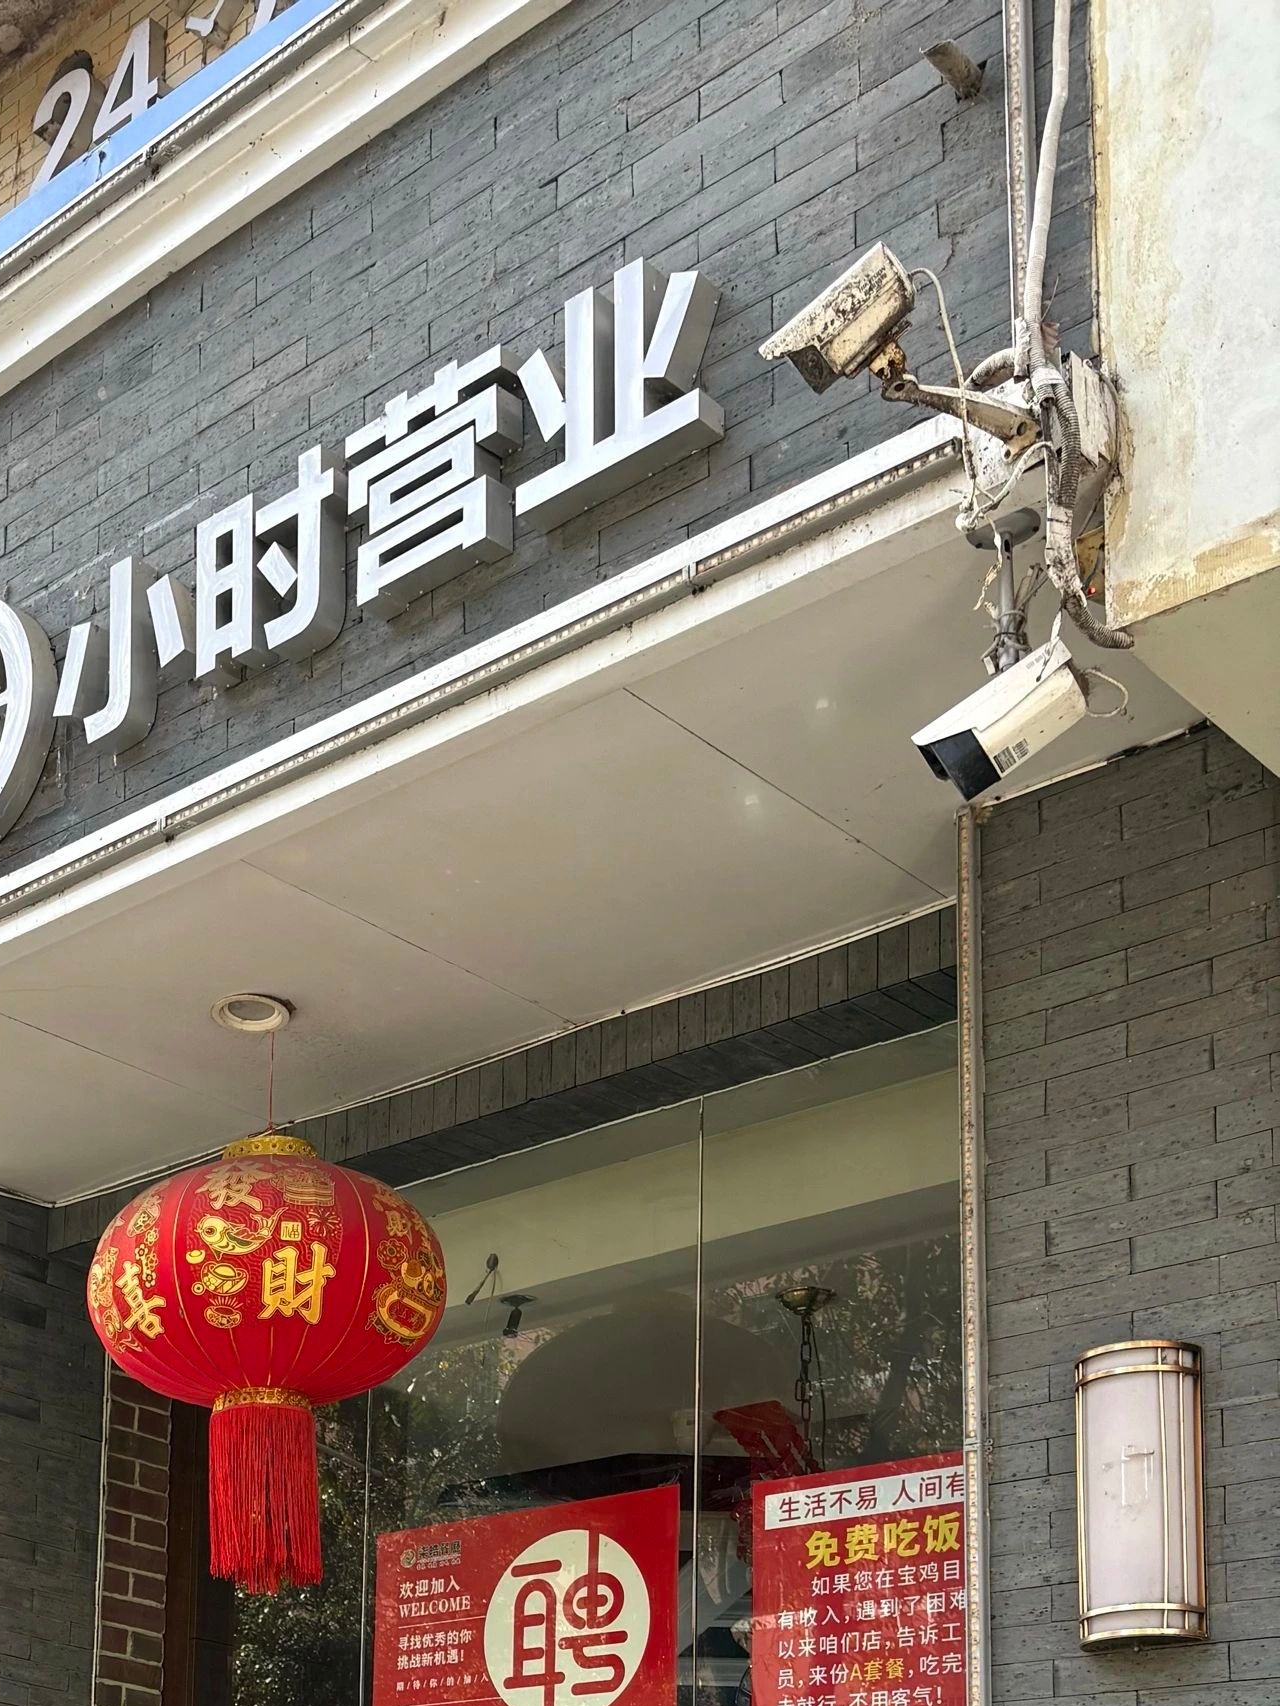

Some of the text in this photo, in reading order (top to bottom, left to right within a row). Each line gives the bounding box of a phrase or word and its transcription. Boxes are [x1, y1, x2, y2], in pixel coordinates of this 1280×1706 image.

[257, 1241, 337, 1324] 財
[778, 1472, 965, 1523] 生活不易 人间有
[805, 1511, 961, 1570] 免费吃饭
[398, 1575, 461, 1599] 欢迎加入
[811, 1559, 961, 1597] 如果您在宝鸡目
[398, 1595, 471, 1619] WELCOME
[397, 1627, 472, 1651] 寻找优秀的你
[777, 1622, 967, 1660] 以来咱们店，告诉工
[396, 1648, 465, 1671] 挑战新机遇！
[777, 1652, 967, 1690] 员，来份A套餐，吃完
